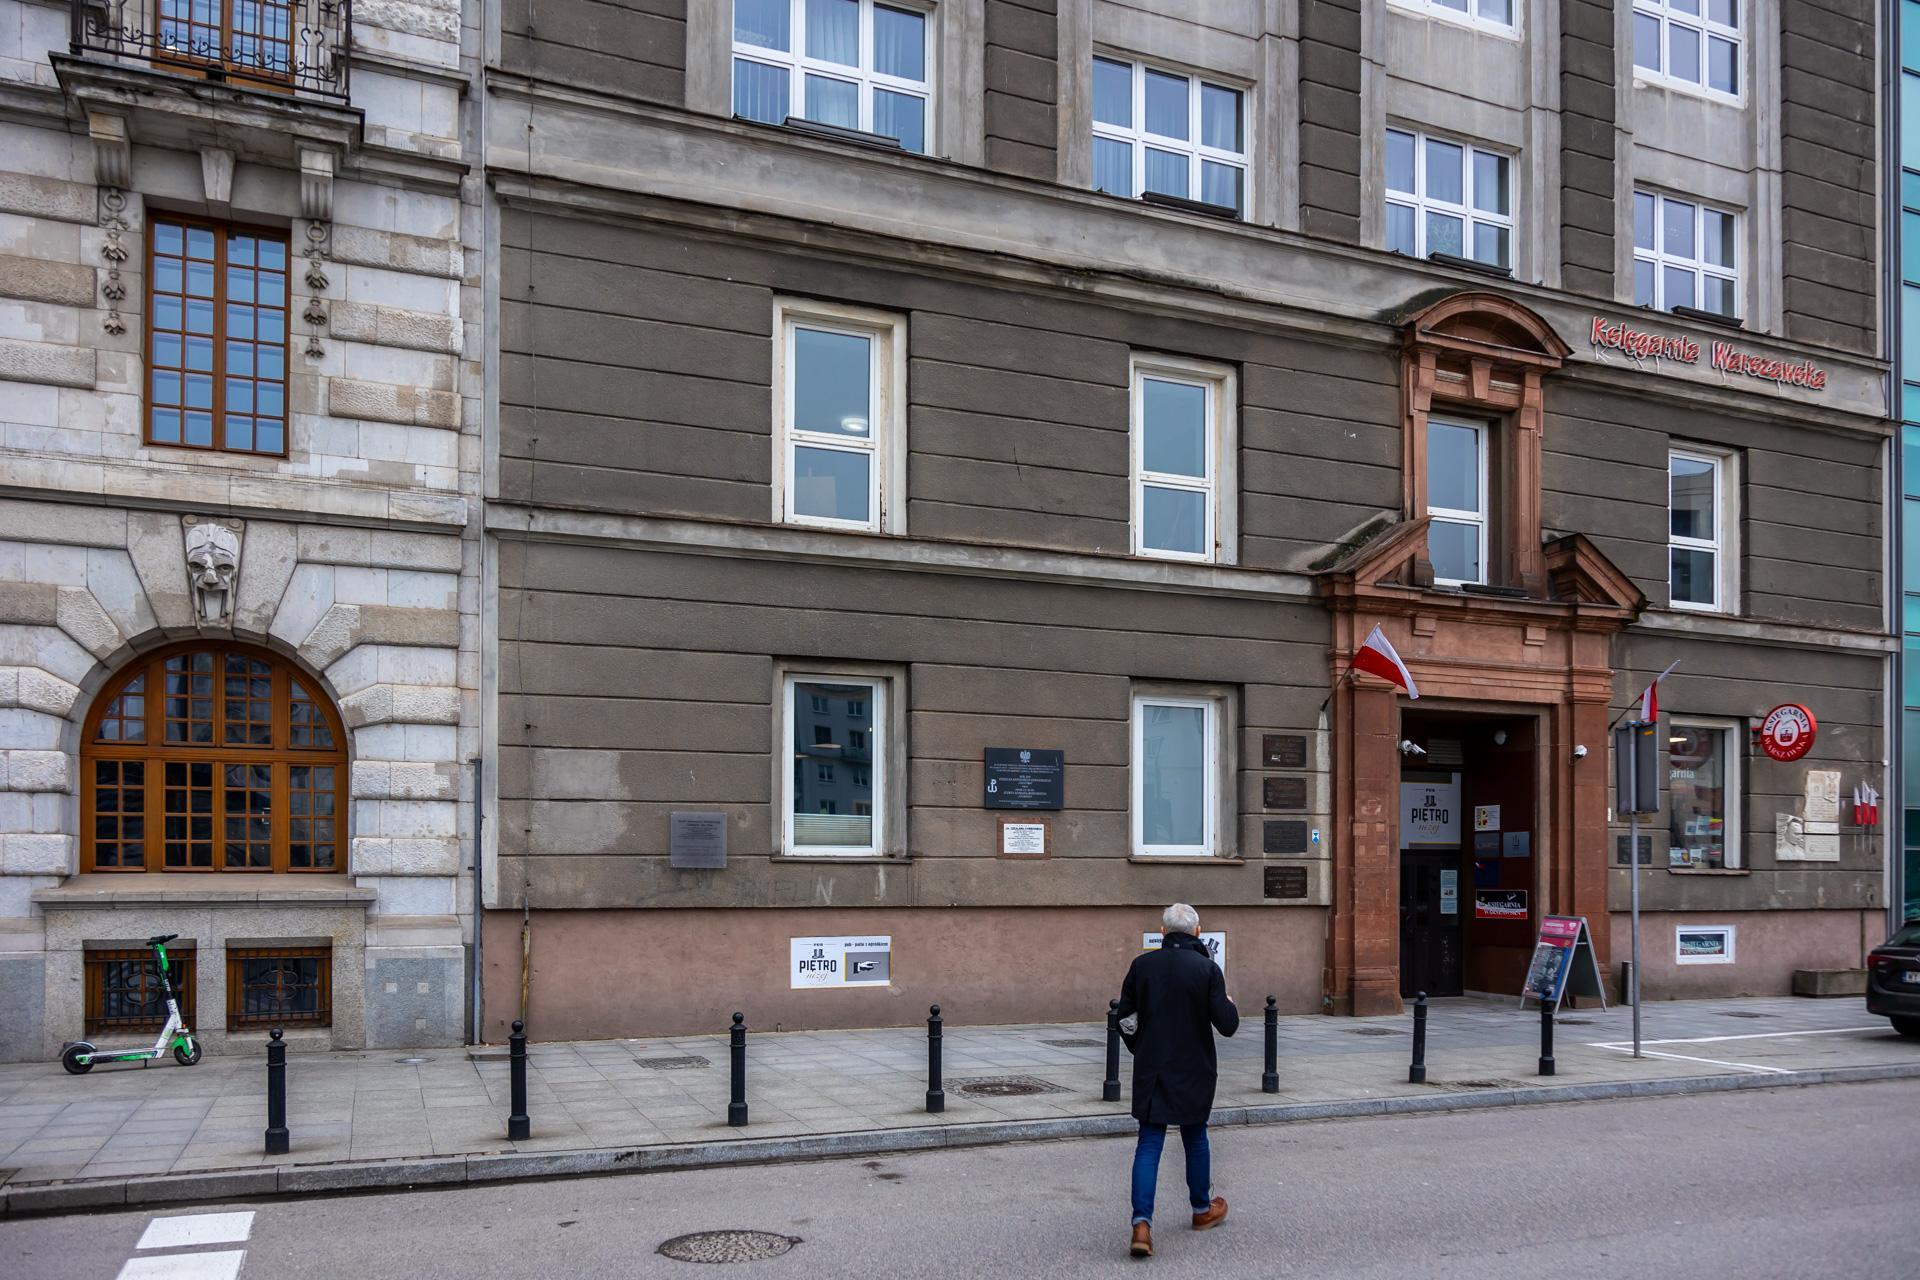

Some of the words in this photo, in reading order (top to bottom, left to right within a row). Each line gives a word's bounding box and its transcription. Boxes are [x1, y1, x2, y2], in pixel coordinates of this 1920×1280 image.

[1591, 315, 1701, 364] Księgarnia
[1711, 340, 1827, 390] Warszawska
[1764, 708, 1809, 732] KSIĘGARNIA
[1764, 734, 1809, 759] WARSZAWSKA
[1670, 767, 1695, 779] arnia
[1411, 808, 1449, 824] PIĘTRO
[799, 960, 837, 974] PIĘTRO
